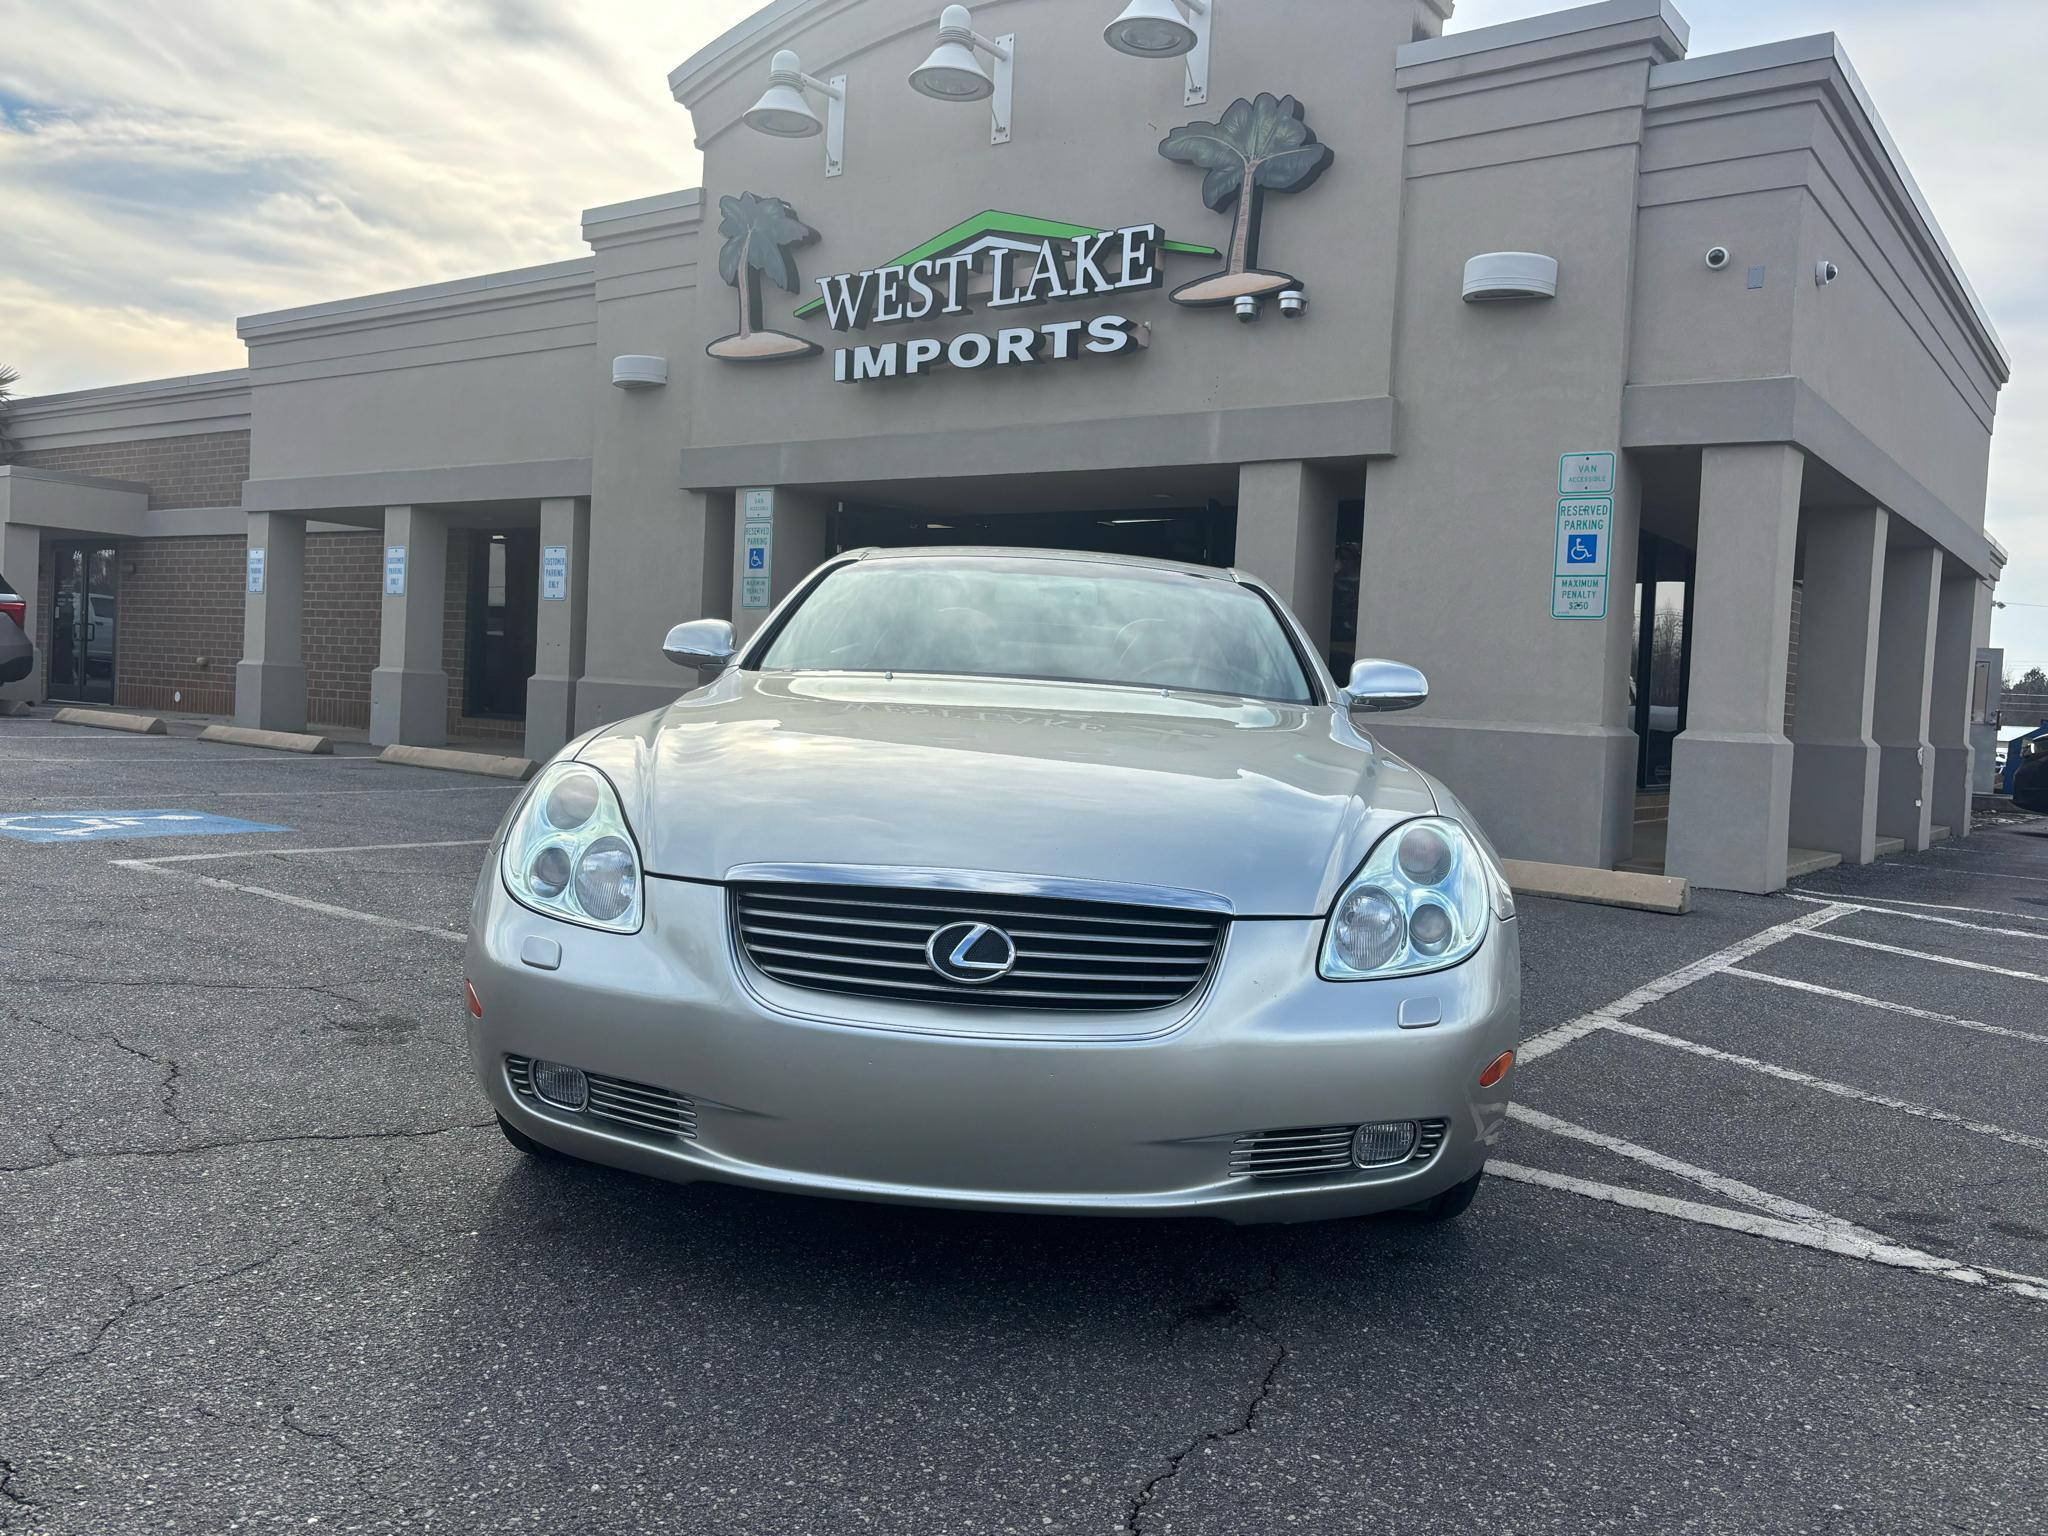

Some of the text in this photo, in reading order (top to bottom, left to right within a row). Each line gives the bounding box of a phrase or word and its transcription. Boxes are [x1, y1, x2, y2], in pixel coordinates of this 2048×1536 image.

[815, 222, 1156, 331] WEST LAKE
[834, 314, 1130, 382] IMPORTS
[1578, 465, 1598, 473] VAN
[1568, 475, 1607, 483] ACCESSIBLE
[1560, 504, 1608, 517] RESERVED
[1563, 519, 1605, 531] PARKING
[1561, 579, 1600, 588] MAXIMUM
[1561, 590, 1597, 599] PENALTY
[1568, 601, 1589, 610] $250
